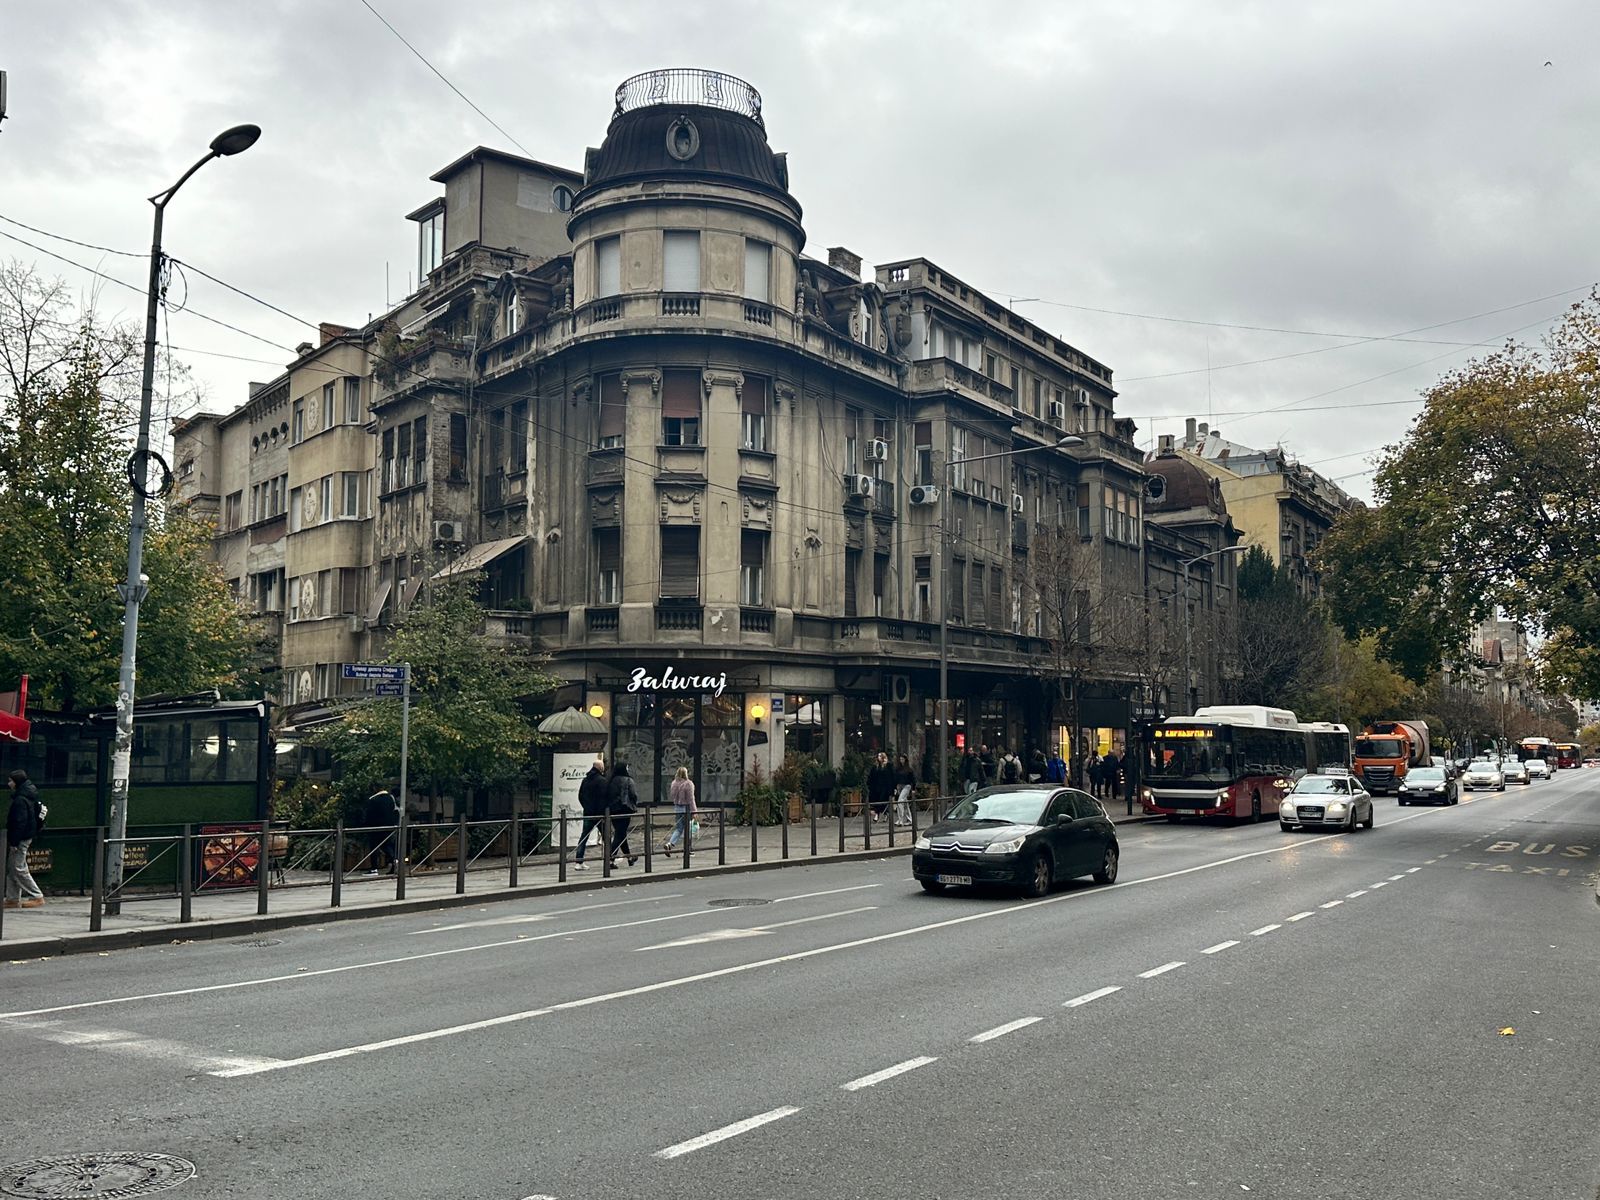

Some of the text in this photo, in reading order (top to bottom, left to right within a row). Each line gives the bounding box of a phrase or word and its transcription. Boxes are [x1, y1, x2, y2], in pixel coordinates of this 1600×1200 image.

[627, 666, 727, 697] Zaburaj
[1484, 840, 1591, 858] BUS
[1463, 862, 1570, 877] TAXI
